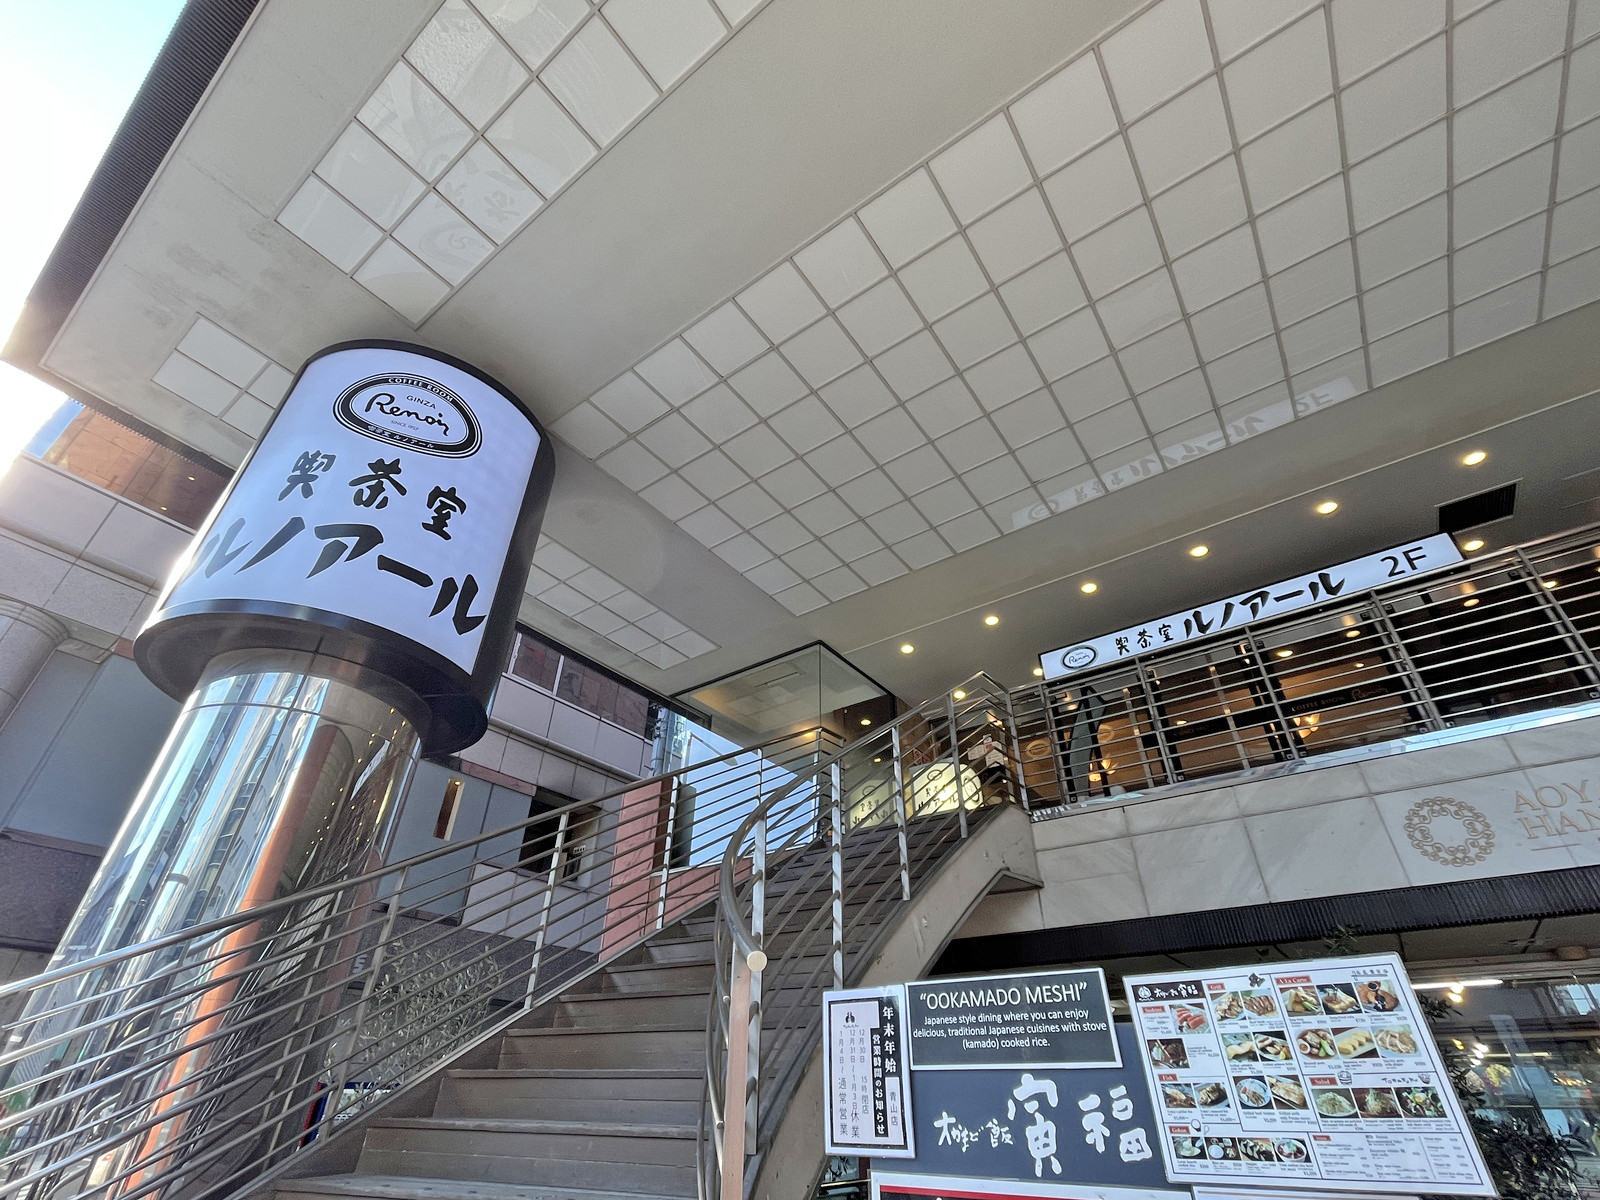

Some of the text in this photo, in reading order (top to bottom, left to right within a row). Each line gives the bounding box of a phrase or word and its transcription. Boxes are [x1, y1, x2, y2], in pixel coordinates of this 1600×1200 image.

[388, 377, 454, 402] COFFEE ROOM
[406, 395, 437, 410] GINZA
[364, 392, 449, 437] Renoir
[278, 449, 467, 541] 喫茶室
[183, 516, 488, 636] ルノアール
[1184, 572, 1346, 638] ルノアール
[1379, 546, 1428, 578] 2F
[913, 1020, 1107, 1039] delicious, traditional Japanese cuisines with stove
[924, 1008, 1090, 1026] Japanese style dining where you can enjoy
[882, 1006, 897, 1073] 年末年始
[962, 1035, 1051, 1050] (kamado) cooked rice.
[872, 1034, 885, 1135] 営業時間のお知らせ
[889, 1091, 899, 1127] 青山店
